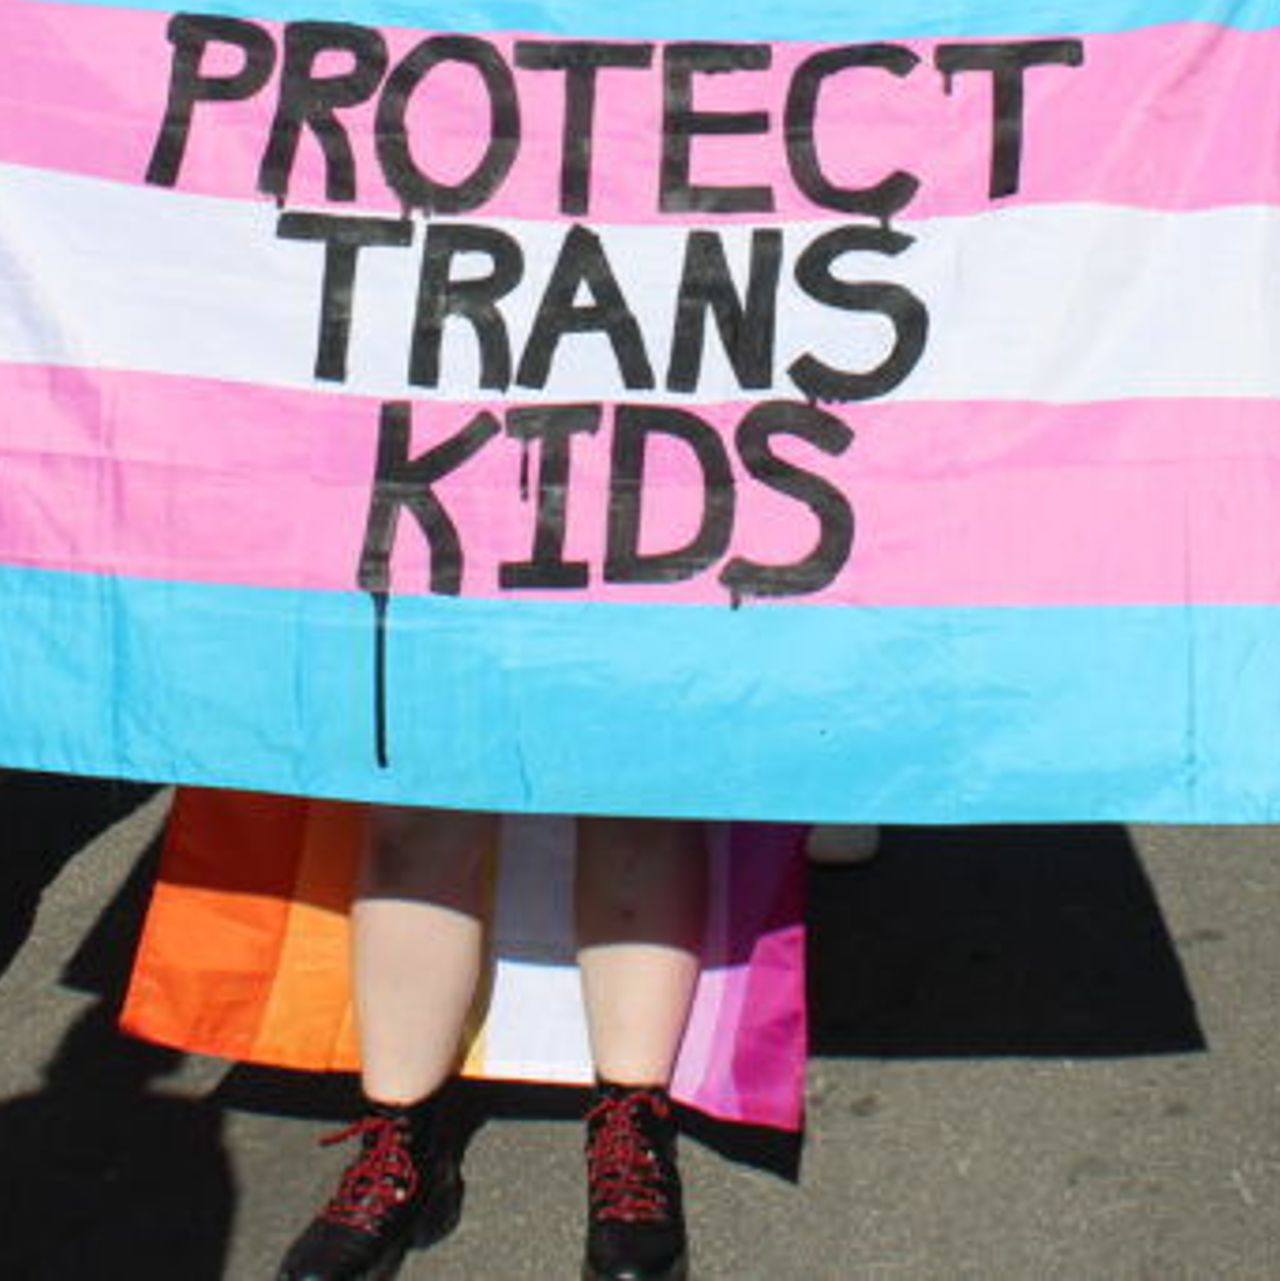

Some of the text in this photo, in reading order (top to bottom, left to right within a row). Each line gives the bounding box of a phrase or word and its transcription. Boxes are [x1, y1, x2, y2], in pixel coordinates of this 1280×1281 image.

[146, 12, 1083, 217] PROTECT
[277, 211, 930, 401] TRANS
[357, 401, 856, 597] KIDS
